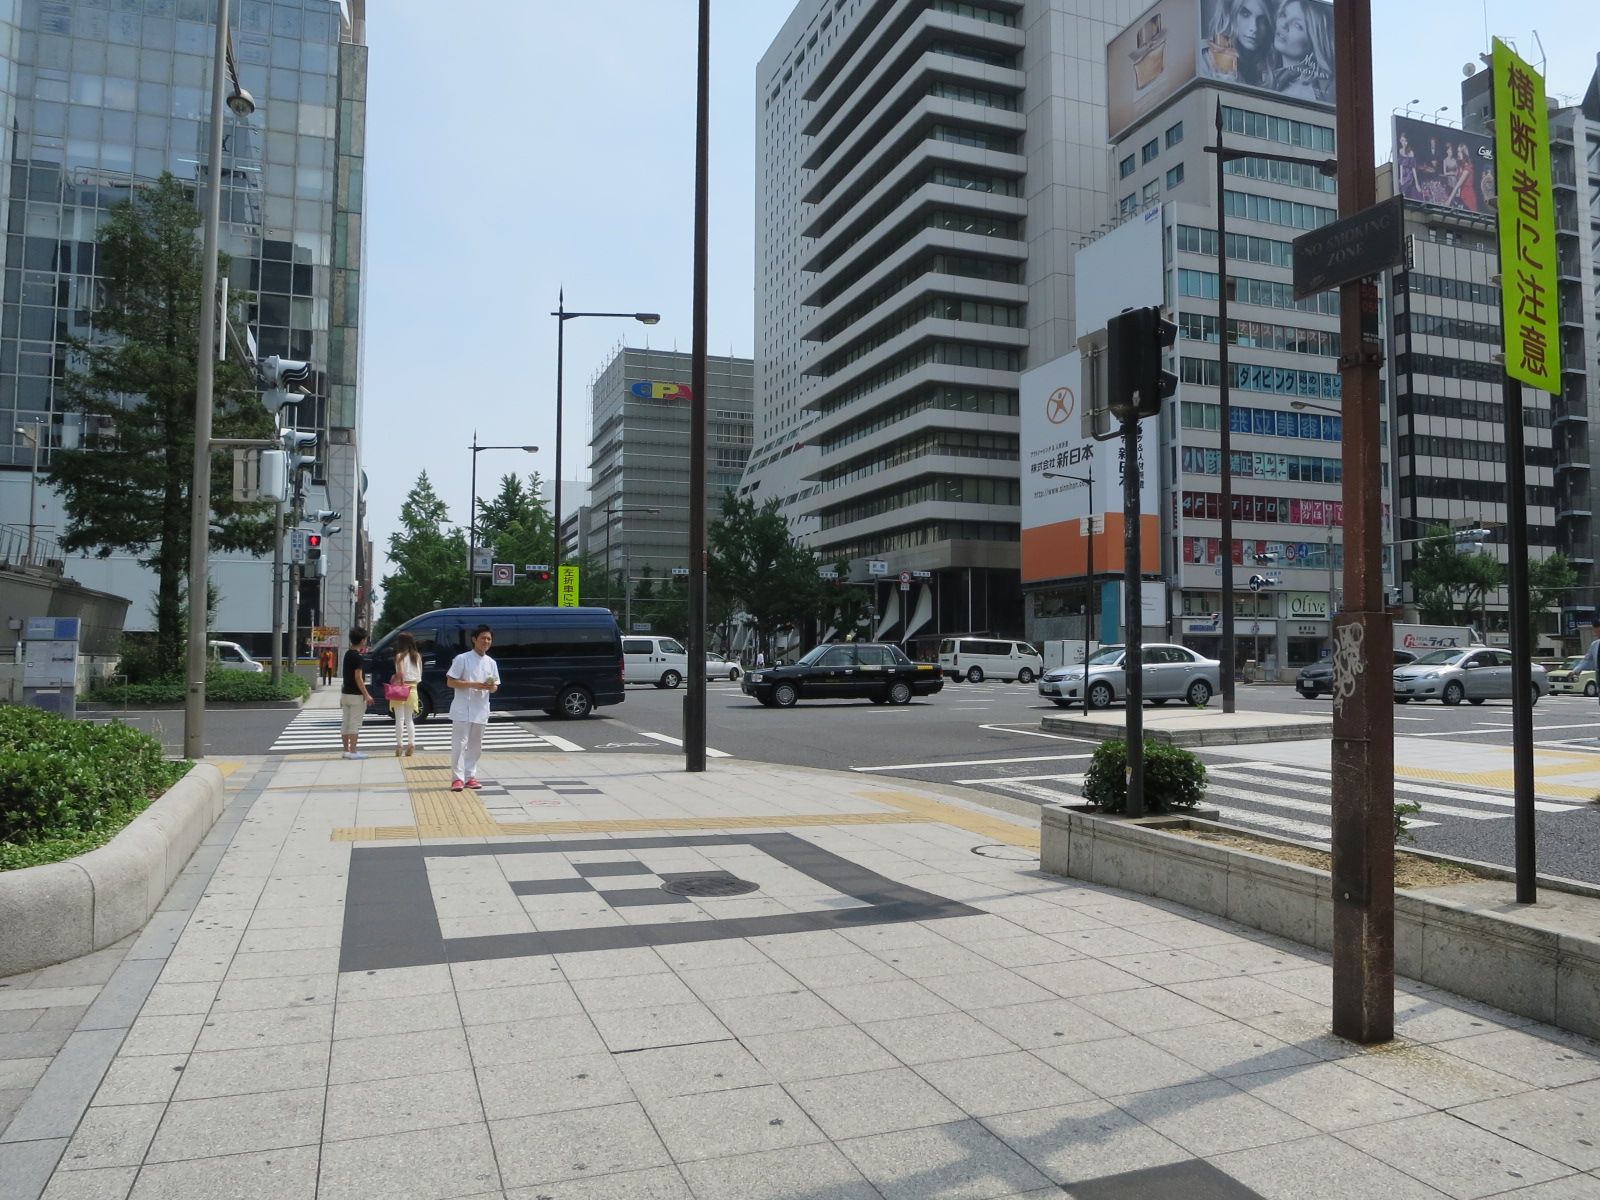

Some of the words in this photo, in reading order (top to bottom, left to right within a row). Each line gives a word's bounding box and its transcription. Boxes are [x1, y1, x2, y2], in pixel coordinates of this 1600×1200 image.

[1507, 62, 1548, 378] 横断者に注意
[1302, 242, 1322, 256] NO
[1327, 214, 1391, 250] SMOKING
[1328, 243, 1365, 266] ZONE
[1240, 367, 1295, 391] ダイビング
[1291, 594, 1326, 613] Olive
